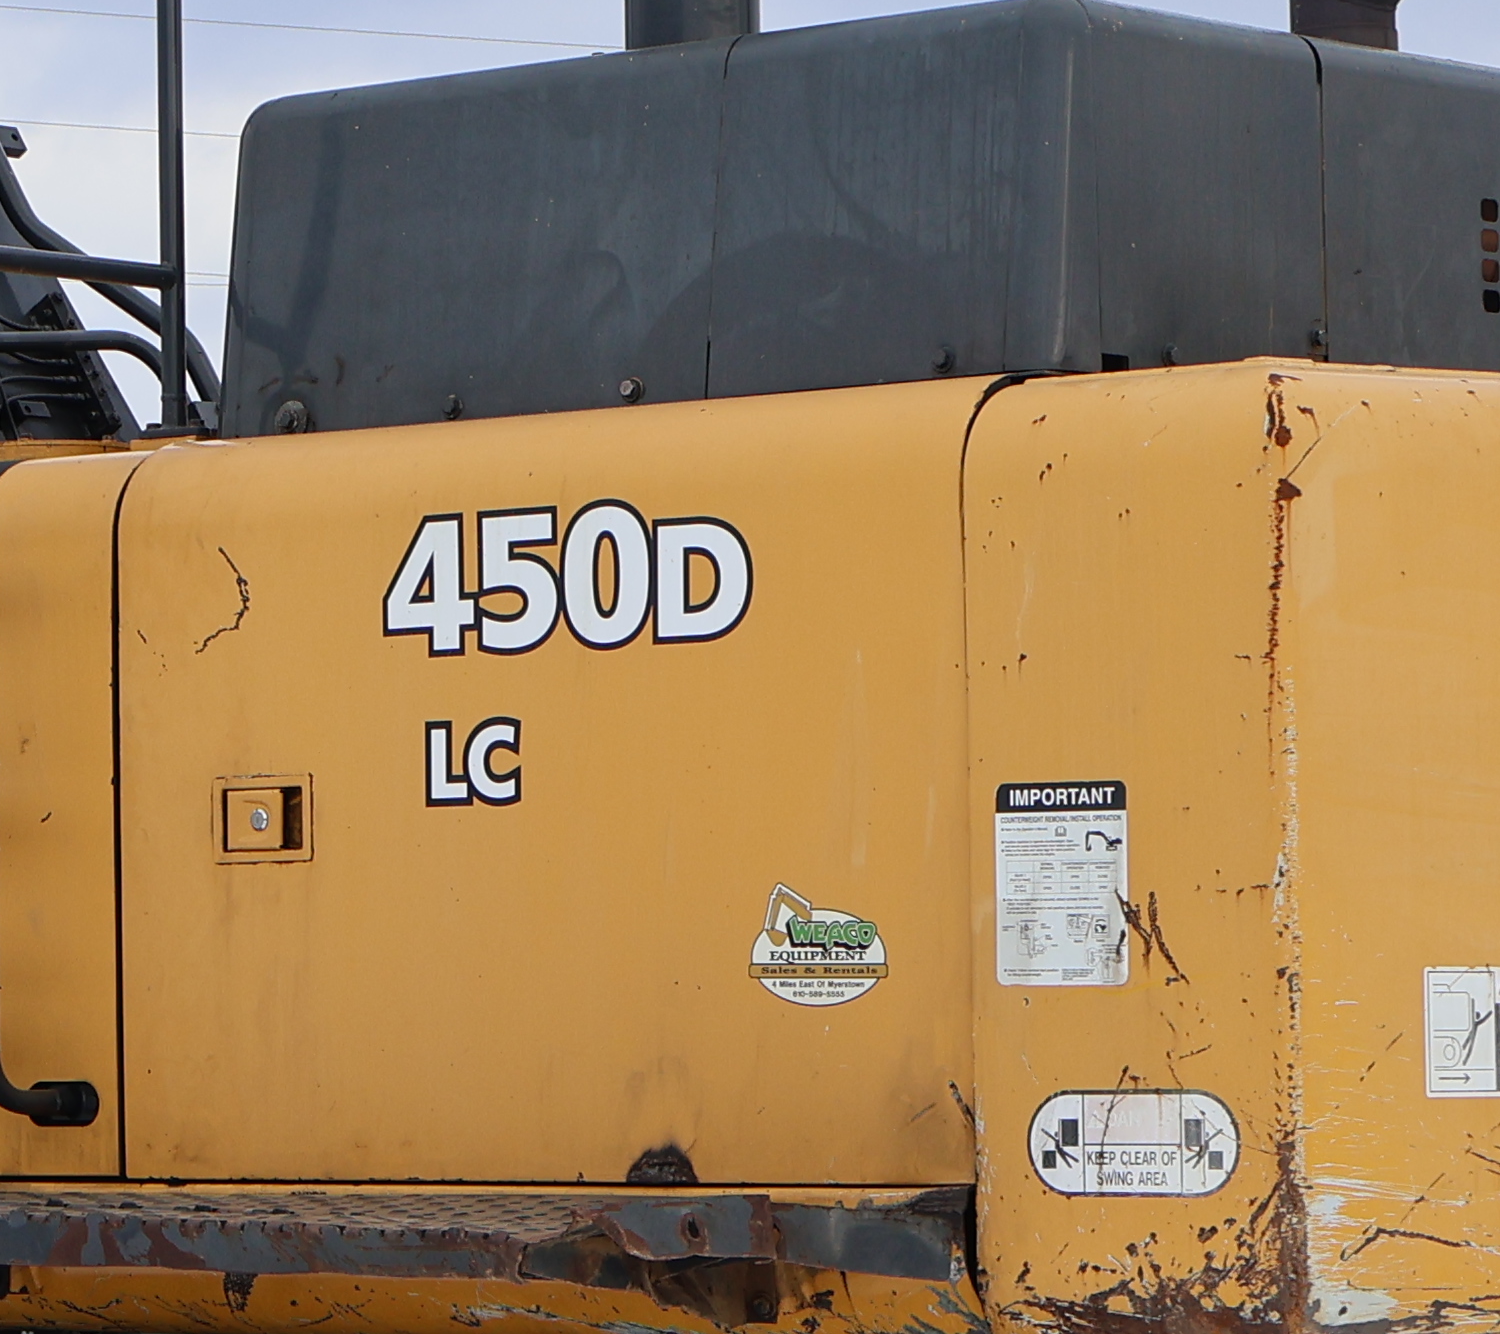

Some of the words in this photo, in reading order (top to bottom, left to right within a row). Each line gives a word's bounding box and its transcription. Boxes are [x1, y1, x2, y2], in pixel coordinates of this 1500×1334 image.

[383, 499, 753, 657] 450D
[425, 716, 522, 807] LC
[1009, 787, 1116, 807] IMPORTANT
[786, 915, 878, 951] WEACO
[768, 950, 868, 964] EQUIPMENT
[761, 966, 798, 975] Sales
[803, 967, 817, 975] &
[822, 966, 879, 975] Rentals
[779, 980, 798, 988] Miles
[798, 980, 815, 988] East
[816, 980, 826, 988] Of
[827, 980, 866, 990] Myerstown
[1086, 1150, 1116, 1166] KEEP
[1119, 1150, 1158, 1166] CLEAR
[1161, 1150, 1178, 1166] OF
[1096, 1170, 1134, 1187] SWING
[1138, 1170, 1169, 1186] AREA
